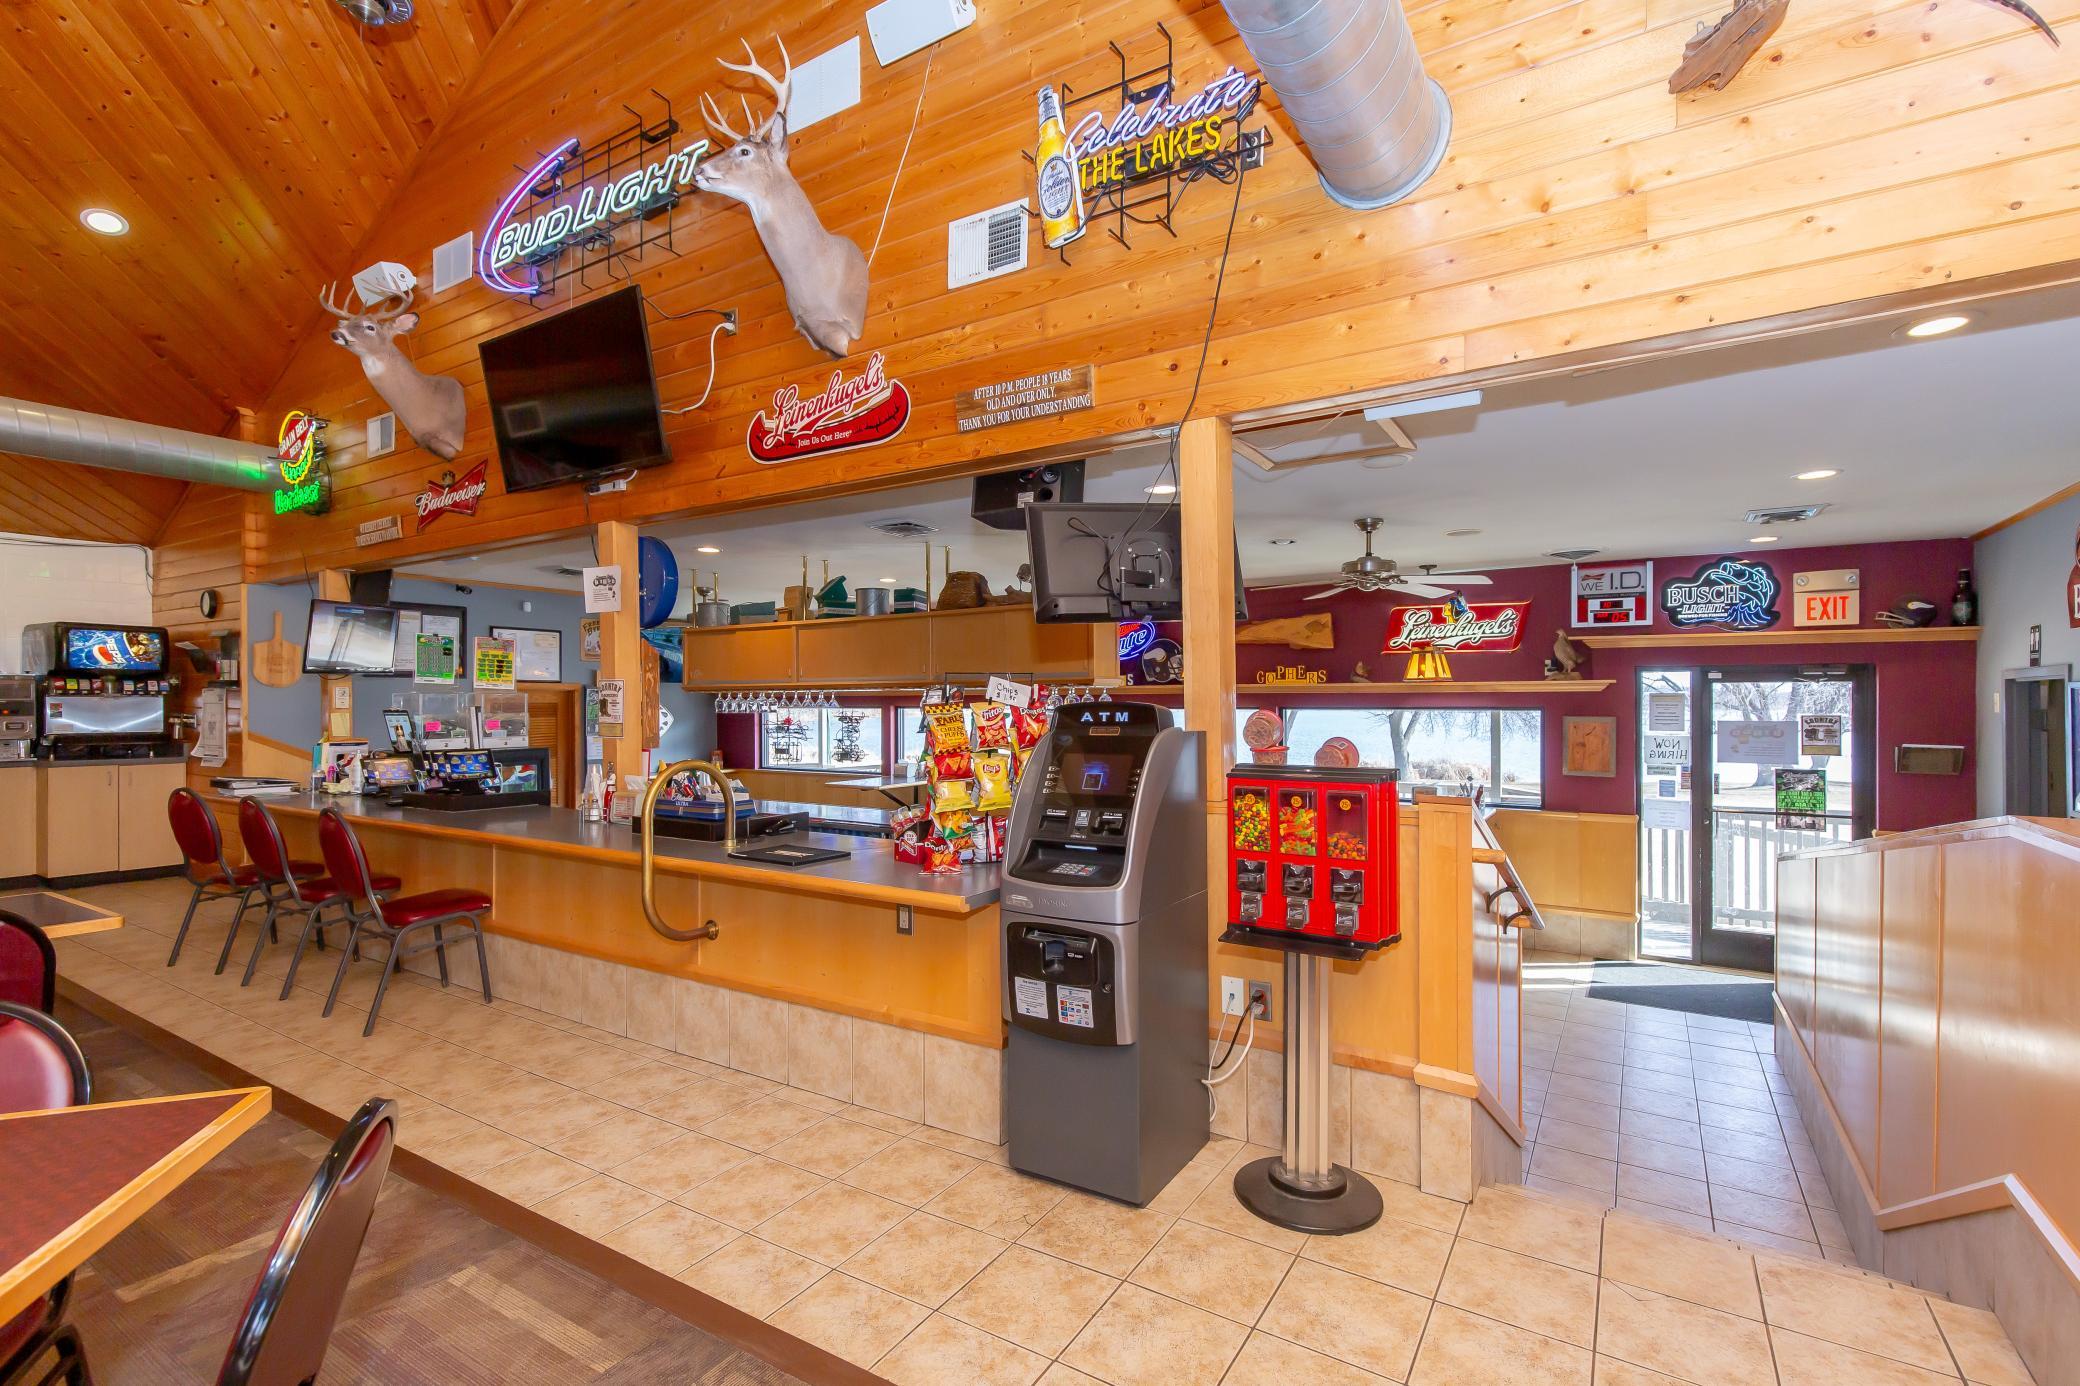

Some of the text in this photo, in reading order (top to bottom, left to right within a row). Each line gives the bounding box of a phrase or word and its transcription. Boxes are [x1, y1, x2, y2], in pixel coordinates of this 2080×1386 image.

[1063, 66, 1260, 162] Celebrate
[1079, 115, 1223, 190] THE LAKES
[493, 139, 709, 269] BUD LIGHT
[974, 384, 993, 400] AFTER
[995, 383, 1001, 396] 10
[1002, 382, 1015, 395] P.M.
[1016, 375, 1042, 391] PEOPLE
[1049, 368, 1072, 384] YEARS
[763, 351, 886, 449] Leinenkugel's
[986, 386, 1057, 411] OLD AND OVER ONLY.
[959, 394, 1091, 431] THANK YOU FOR YOUR UNDERSTANDING
[279, 428, 296, 456] GRAIN
[294, 415, 309, 438] BELT
[798, 431, 848, 448] Join Us Out Here
[289, 438, 302, 459] BEER
[414, 480, 488, 518] Budweiser
[1581, 581, 1604, 592] WE
[1611, 571, 1645, 590] I.D.
[1667, 584, 1740, 607] BUSCH
[1806, 596, 1850, 621] EXIT
[1389, 608, 1516, 650] Leinenkugel's
[1257, 665, 1326, 684] GOPHERS
[996, 682, 1019, 696] Chips
[1080, 711, 1129, 722] ATM
